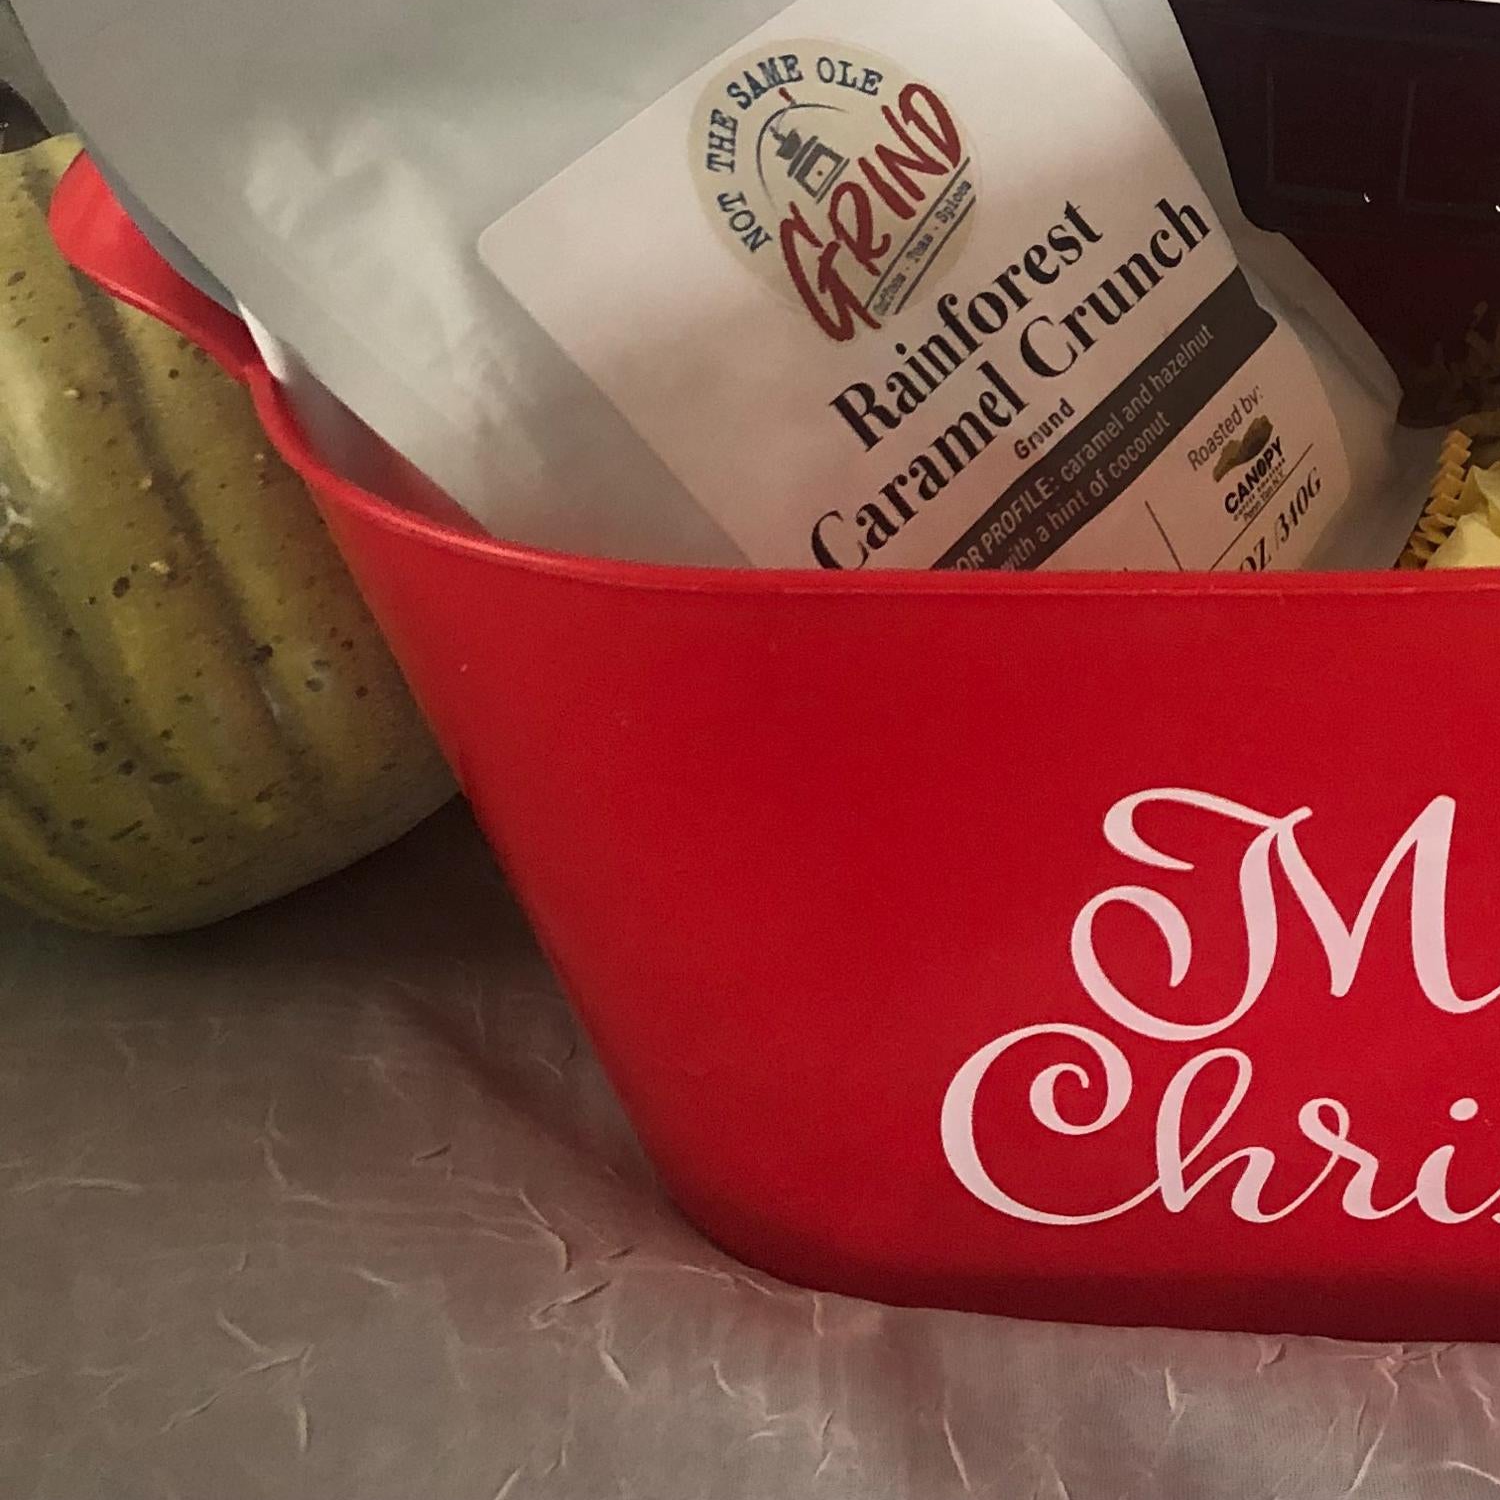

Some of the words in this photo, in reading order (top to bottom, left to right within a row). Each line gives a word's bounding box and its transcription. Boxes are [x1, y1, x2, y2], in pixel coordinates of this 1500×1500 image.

[727, 54, 804, 110] SAME
[816, 57, 883, 96] OLE
[707, 109, 738, 172] THE
[717, 192, 772, 253] NOT
[780, 83, 961, 342] GRIND
[829, 201, 1103, 452] Rainforest
[811, 360, 1029, 571] Caramel
[1020, 198, 1211, 378] Crunch
[981, 475, 1060, 554] PROFILE:
[1060, 412, 1125, 483] caramel
[1122, 384, 1152, 422] and
[1149, 324, 1215, 392] hazelnut
[1014, 397, 1076, 460] Ground
[1187, 404, 1243, 471] Roasted
[1036, 524, 1051, 543] a
[1047, 490, 1090, 532] hint
[1089, 469, 1110, 498] of
[1108, 411, 1171, 479] coconut
[1224, 436, 1284, 514] CANOPY
